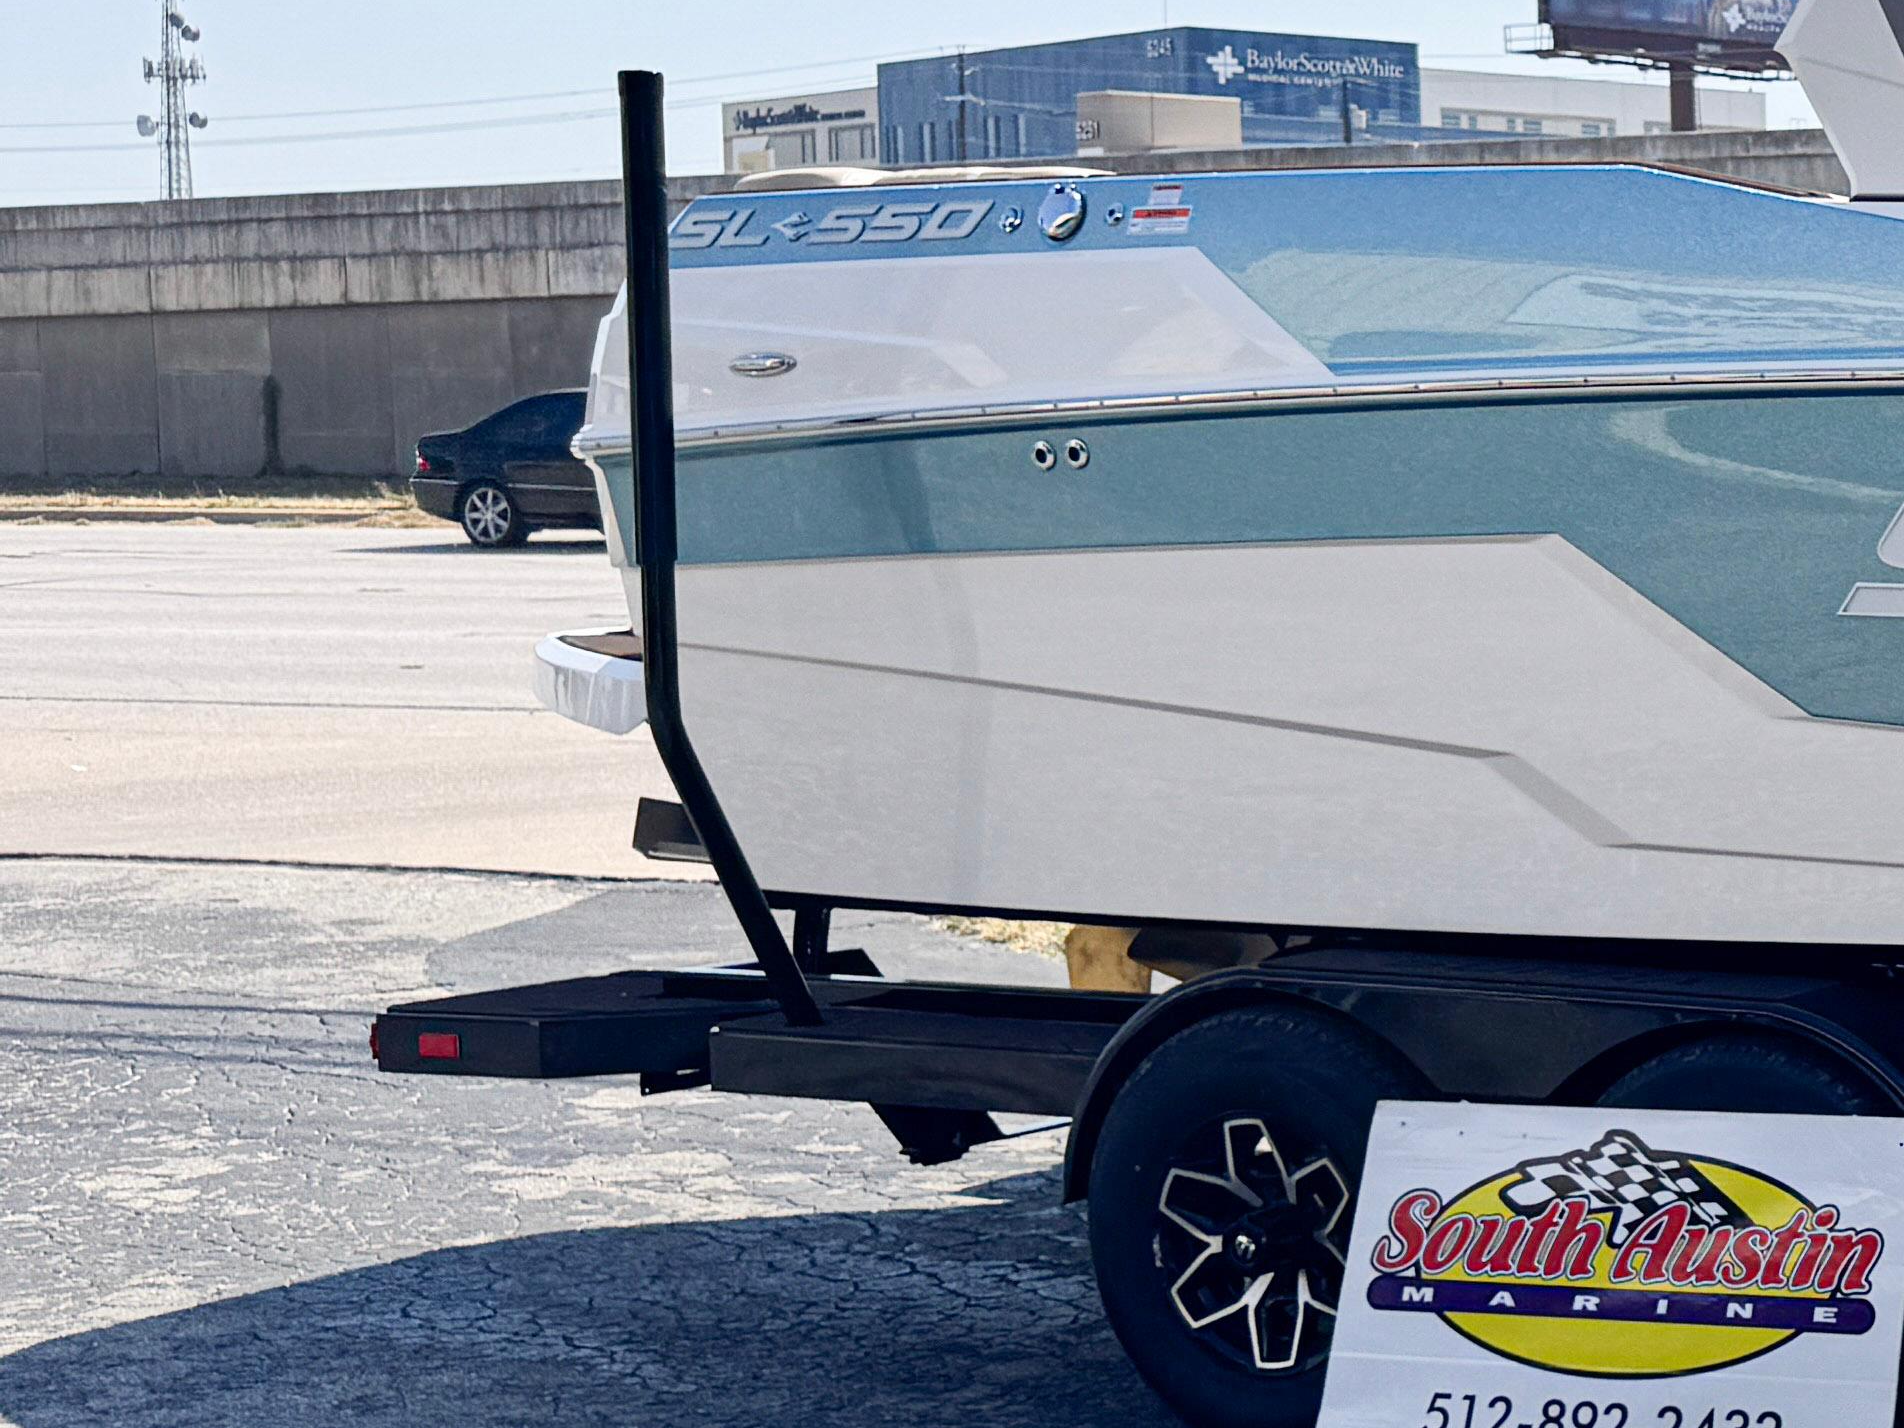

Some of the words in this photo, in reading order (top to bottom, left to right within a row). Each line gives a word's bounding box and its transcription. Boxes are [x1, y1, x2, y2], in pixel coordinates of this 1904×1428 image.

[669, 209, 771, 250] SL
[806, 199, 996, 247] 550
[1373, 1189, 1608, 1281] South
[1609, 1199, 1885, 1295] Austin
[1401, 1285, 1839, 1325] MARINE
